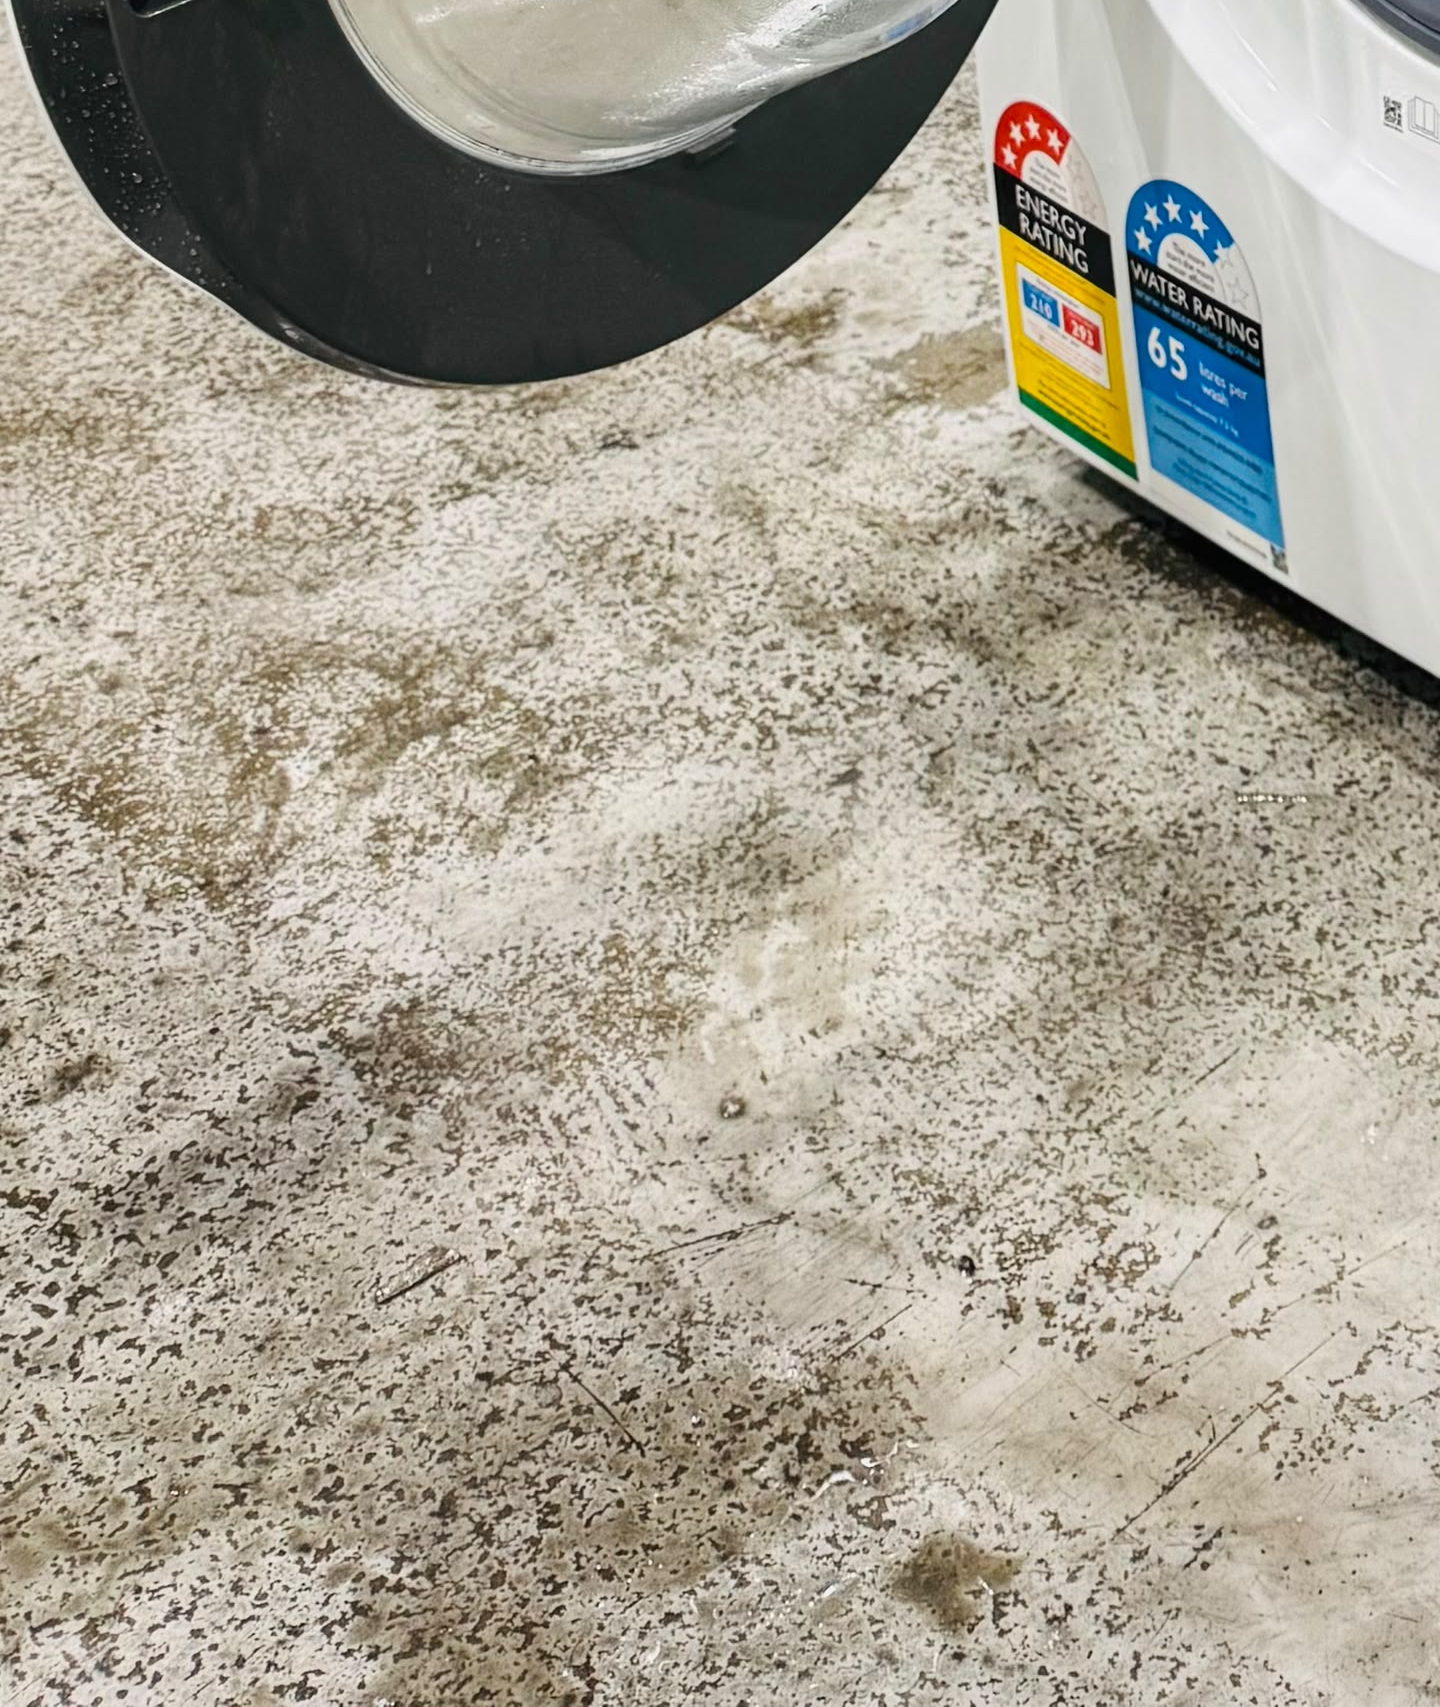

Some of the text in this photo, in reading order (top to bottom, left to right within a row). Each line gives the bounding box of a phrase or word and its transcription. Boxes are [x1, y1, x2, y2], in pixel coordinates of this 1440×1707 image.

[1015, 184, 1087, 246] ENERGY
[1019, 213, 1089, 274] RATING
[1029, 293, 1053, 320] 210
[1070, 319, 1094, 346] 293
[1129, 258, 1189, 311] WATER
[1192, 295, 1260, 350] RATING
[1147, 326, 1188, 381] 65
